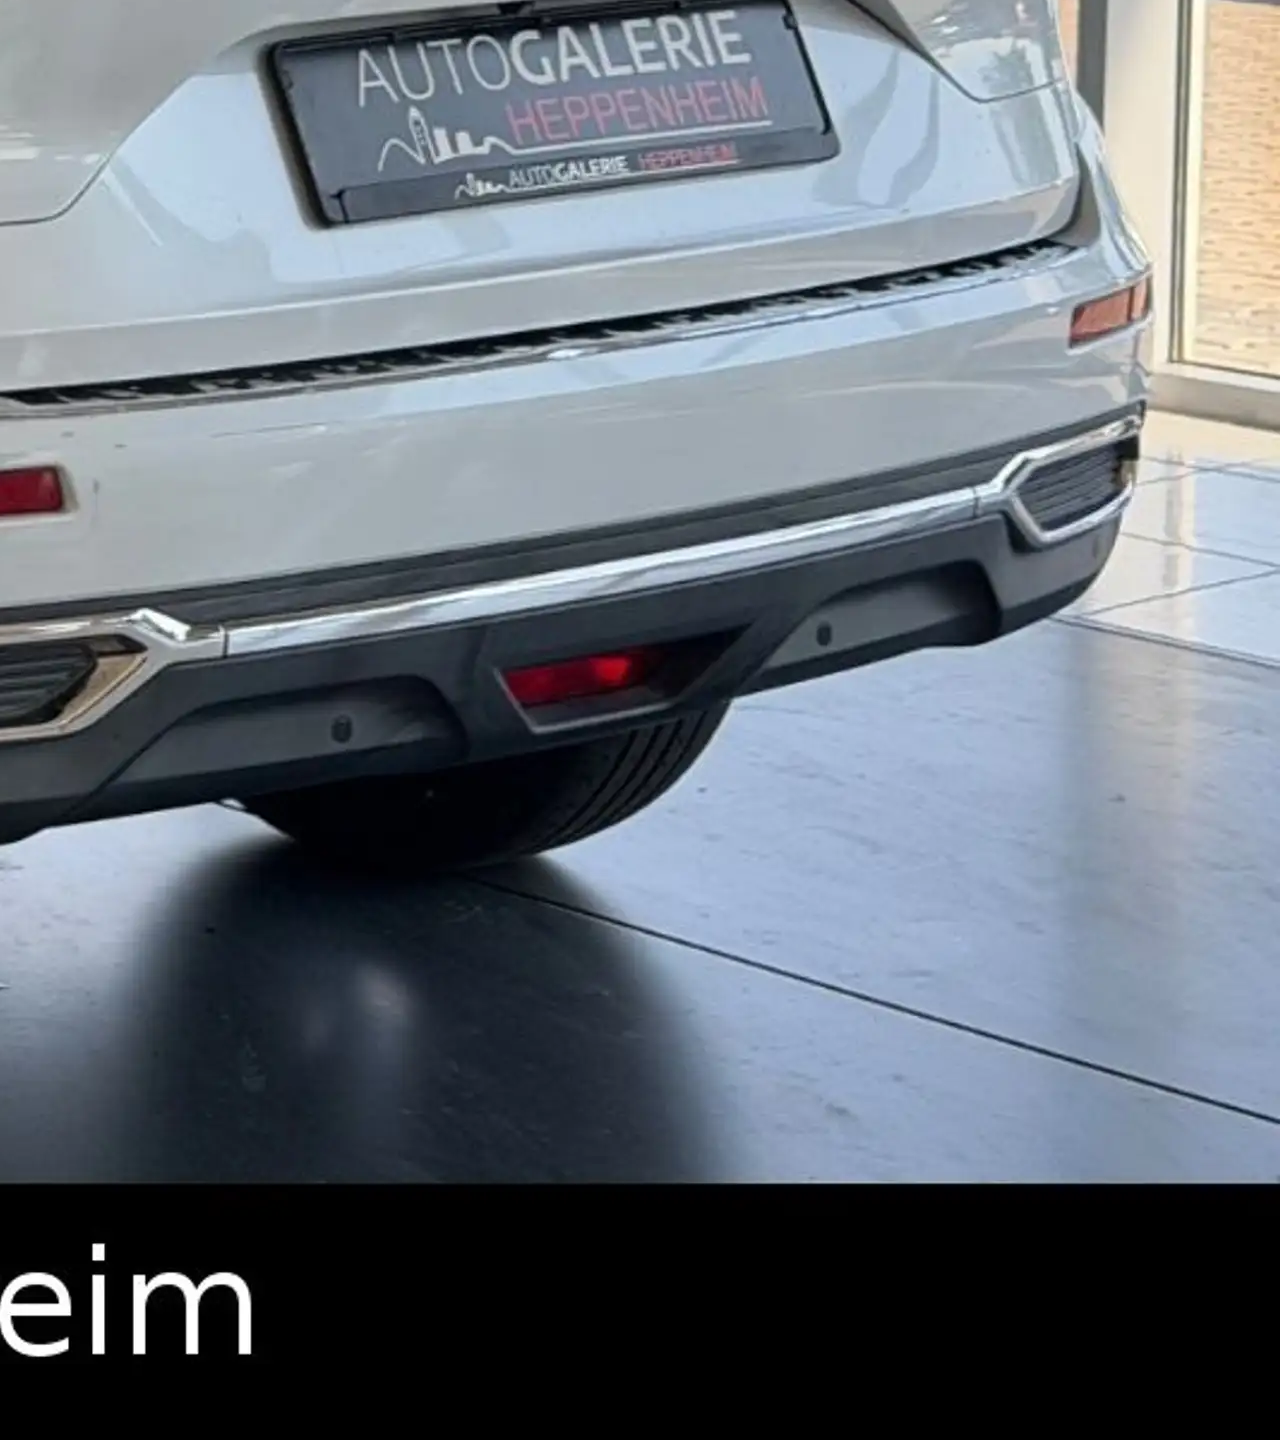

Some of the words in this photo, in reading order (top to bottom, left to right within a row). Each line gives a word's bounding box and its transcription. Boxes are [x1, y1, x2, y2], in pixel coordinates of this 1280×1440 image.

[358, 10, 752, 108] AUTOGALERIE
[504, 75, 769, 146] HEPPENHEIM
[508, 154, 630, 187] AUTOGALERIE
